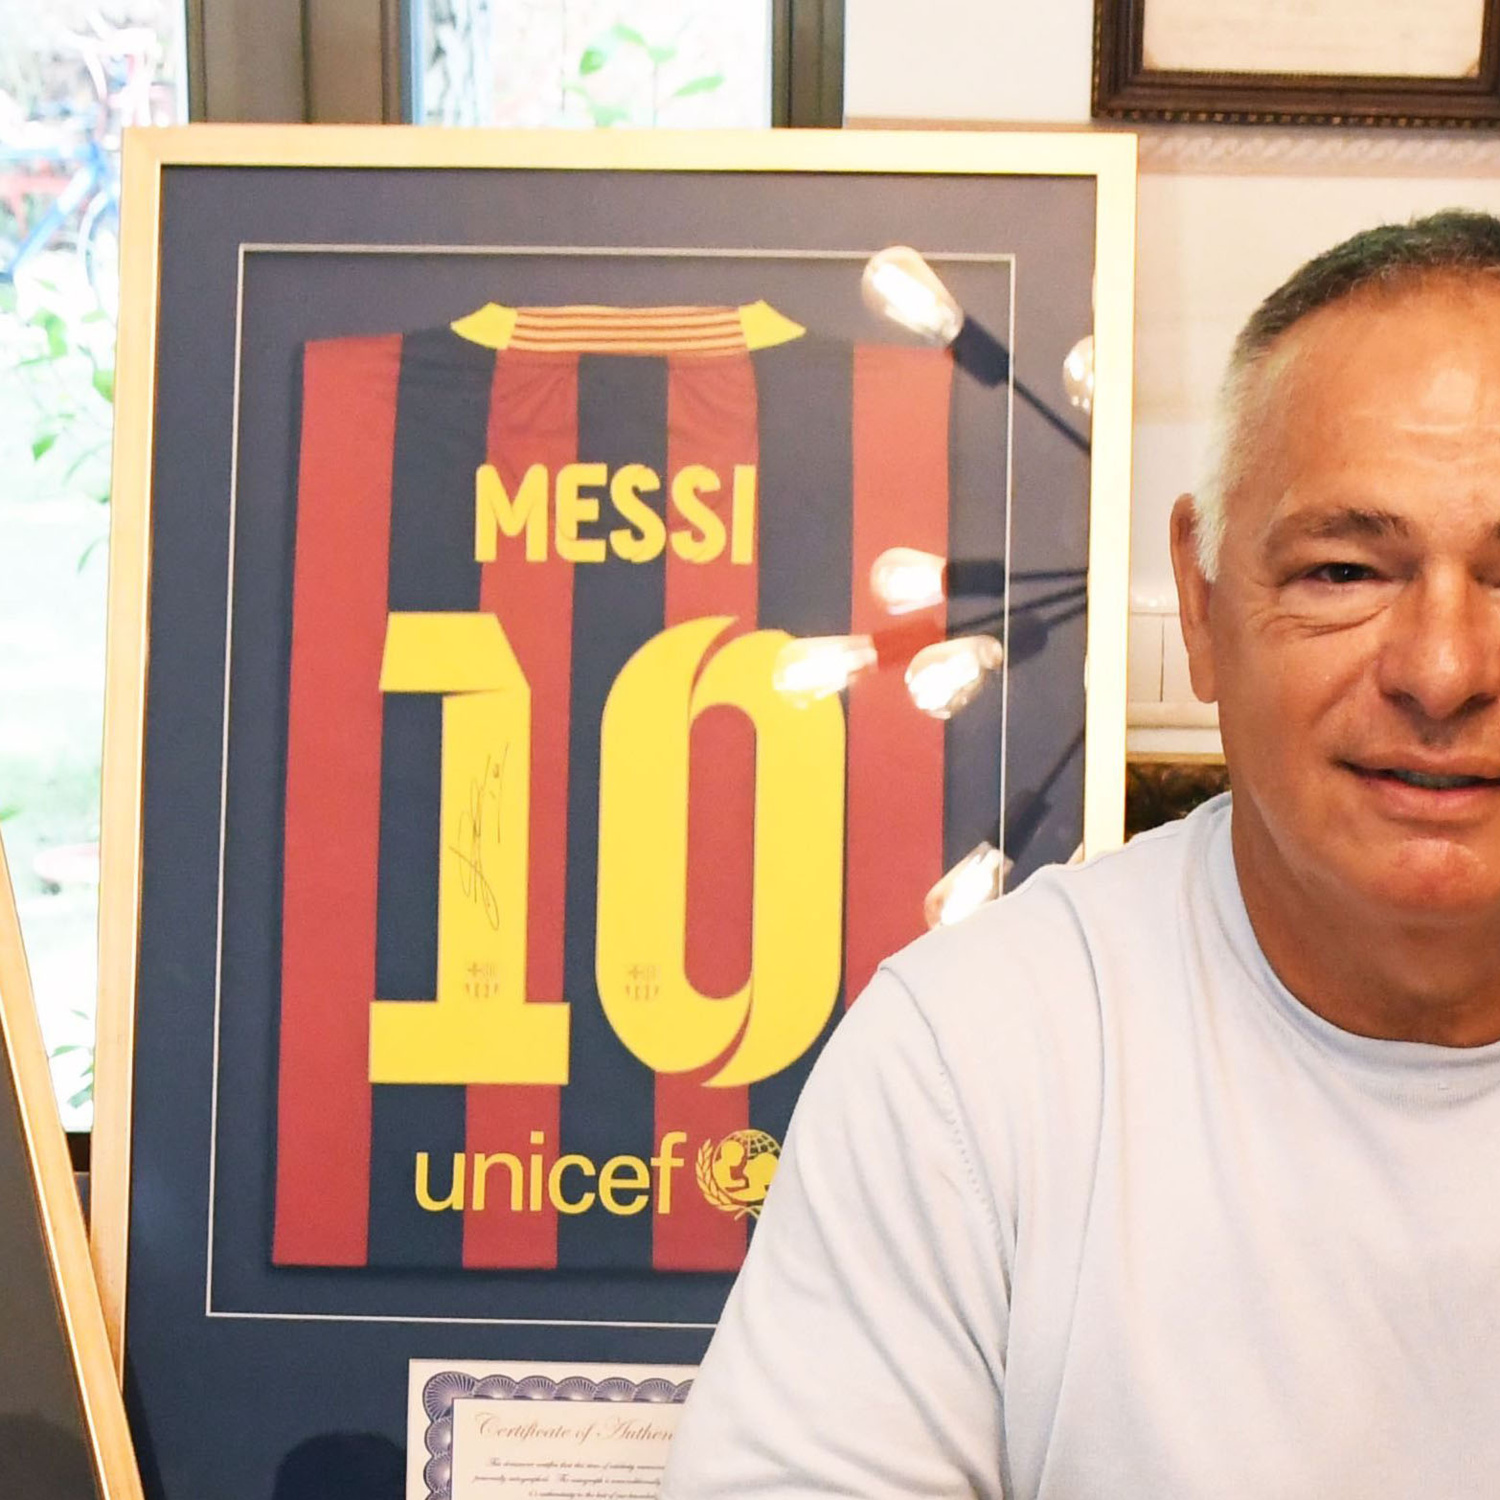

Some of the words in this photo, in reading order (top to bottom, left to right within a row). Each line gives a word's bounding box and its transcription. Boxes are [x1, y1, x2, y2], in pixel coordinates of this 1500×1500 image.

[475, 463, 757, 565] MESSI
[368, 612, 847, 1088] 10
[414, 1130, 688, 1216] unicef
[474, 1412, 571, 1443] Certificate
[574, 1424, 594, 1445] of
